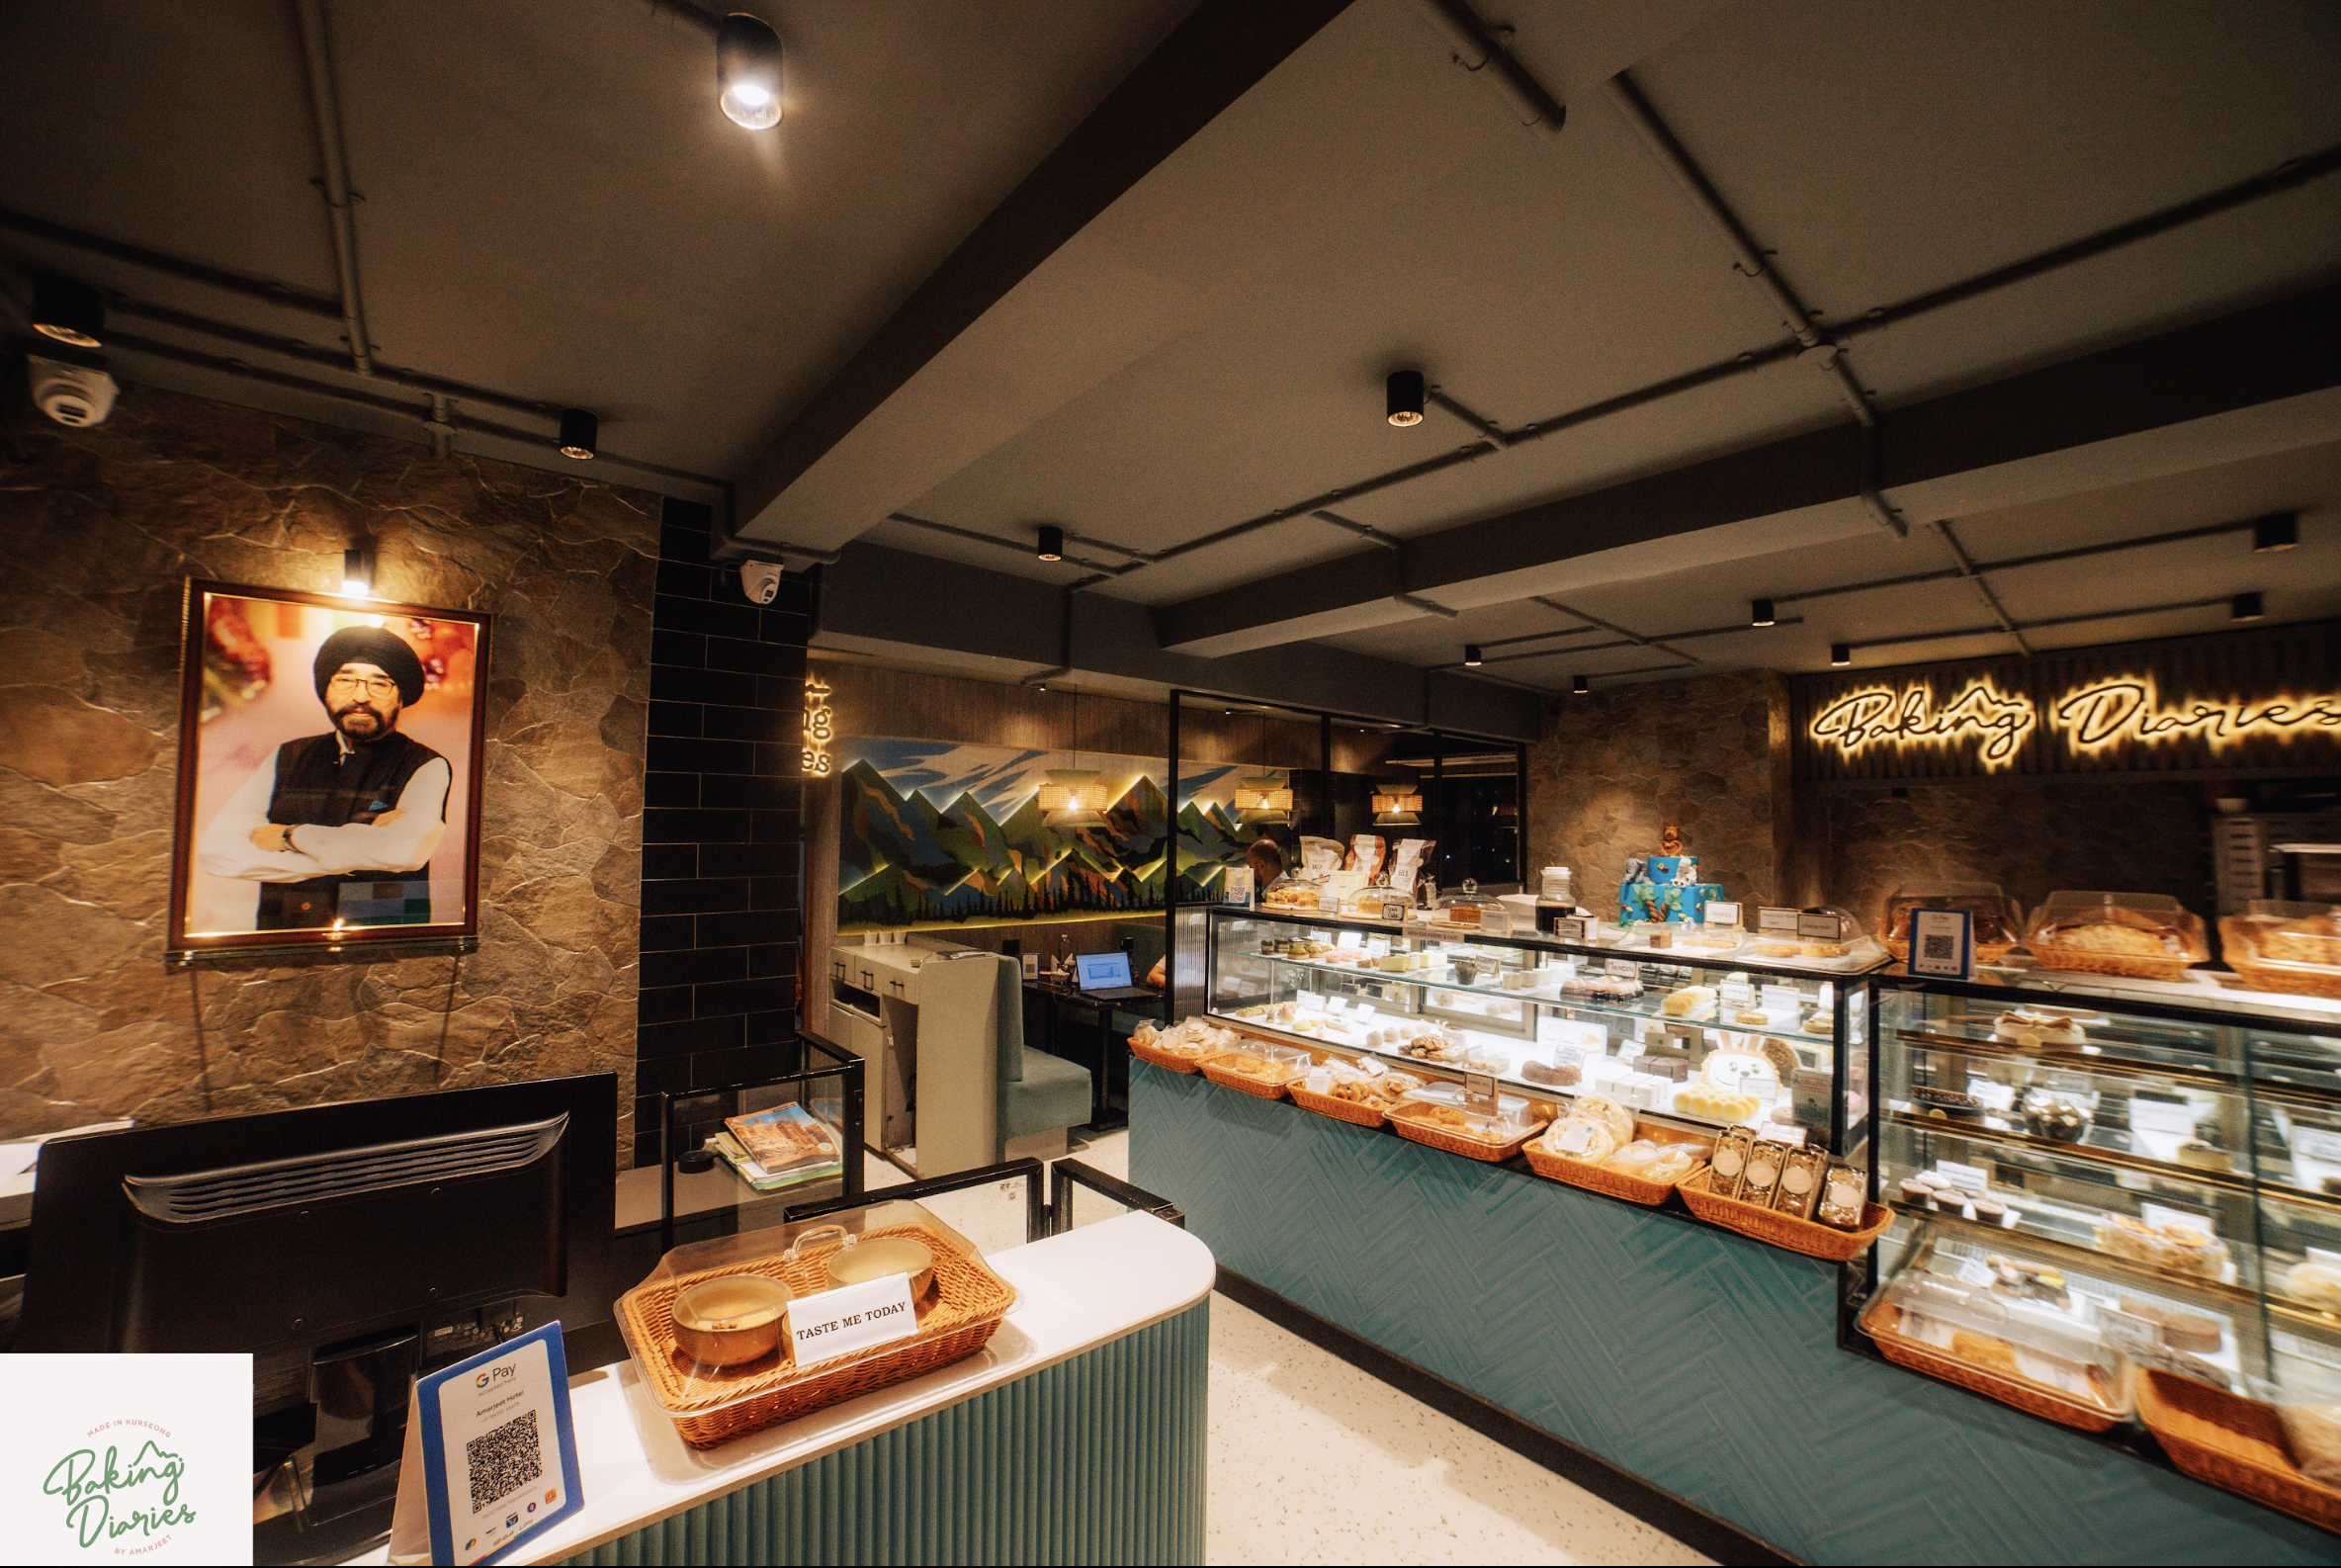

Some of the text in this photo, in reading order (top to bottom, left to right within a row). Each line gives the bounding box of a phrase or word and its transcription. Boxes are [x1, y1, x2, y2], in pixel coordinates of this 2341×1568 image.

[1813, 683, 2341, 759] Baking Diaries
[797, 1301, 906, 1341] TASTE ME TODAY
[492, 1363, 516, 1381] Pay
[478, 1381, 503, 1397] accepted
[476, 1390, 524, 1418] Amarjeet Hotel
